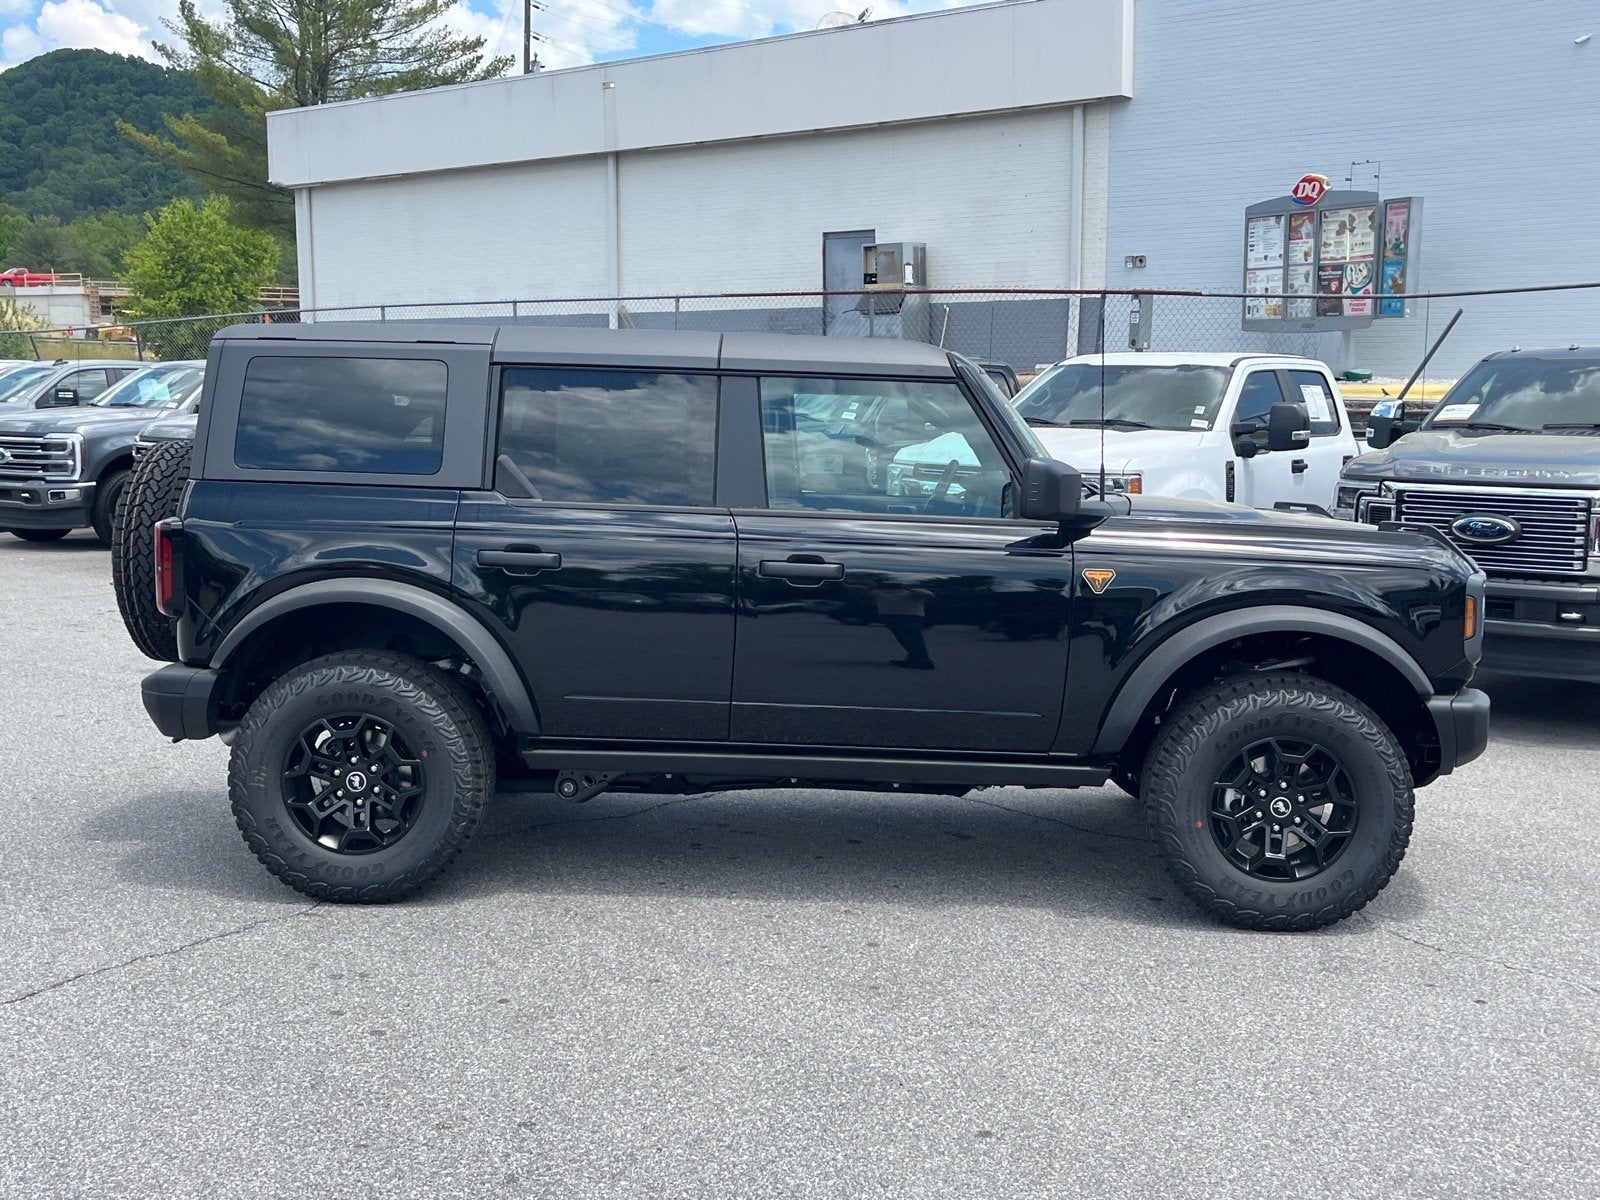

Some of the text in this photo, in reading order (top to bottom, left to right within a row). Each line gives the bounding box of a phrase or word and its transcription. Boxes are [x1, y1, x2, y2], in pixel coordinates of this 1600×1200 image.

[1297, 181, 1320, 198] DQ
[1414, 465, 1498, 476] SUPER
[1467, 521, 1499, 537] Ford
